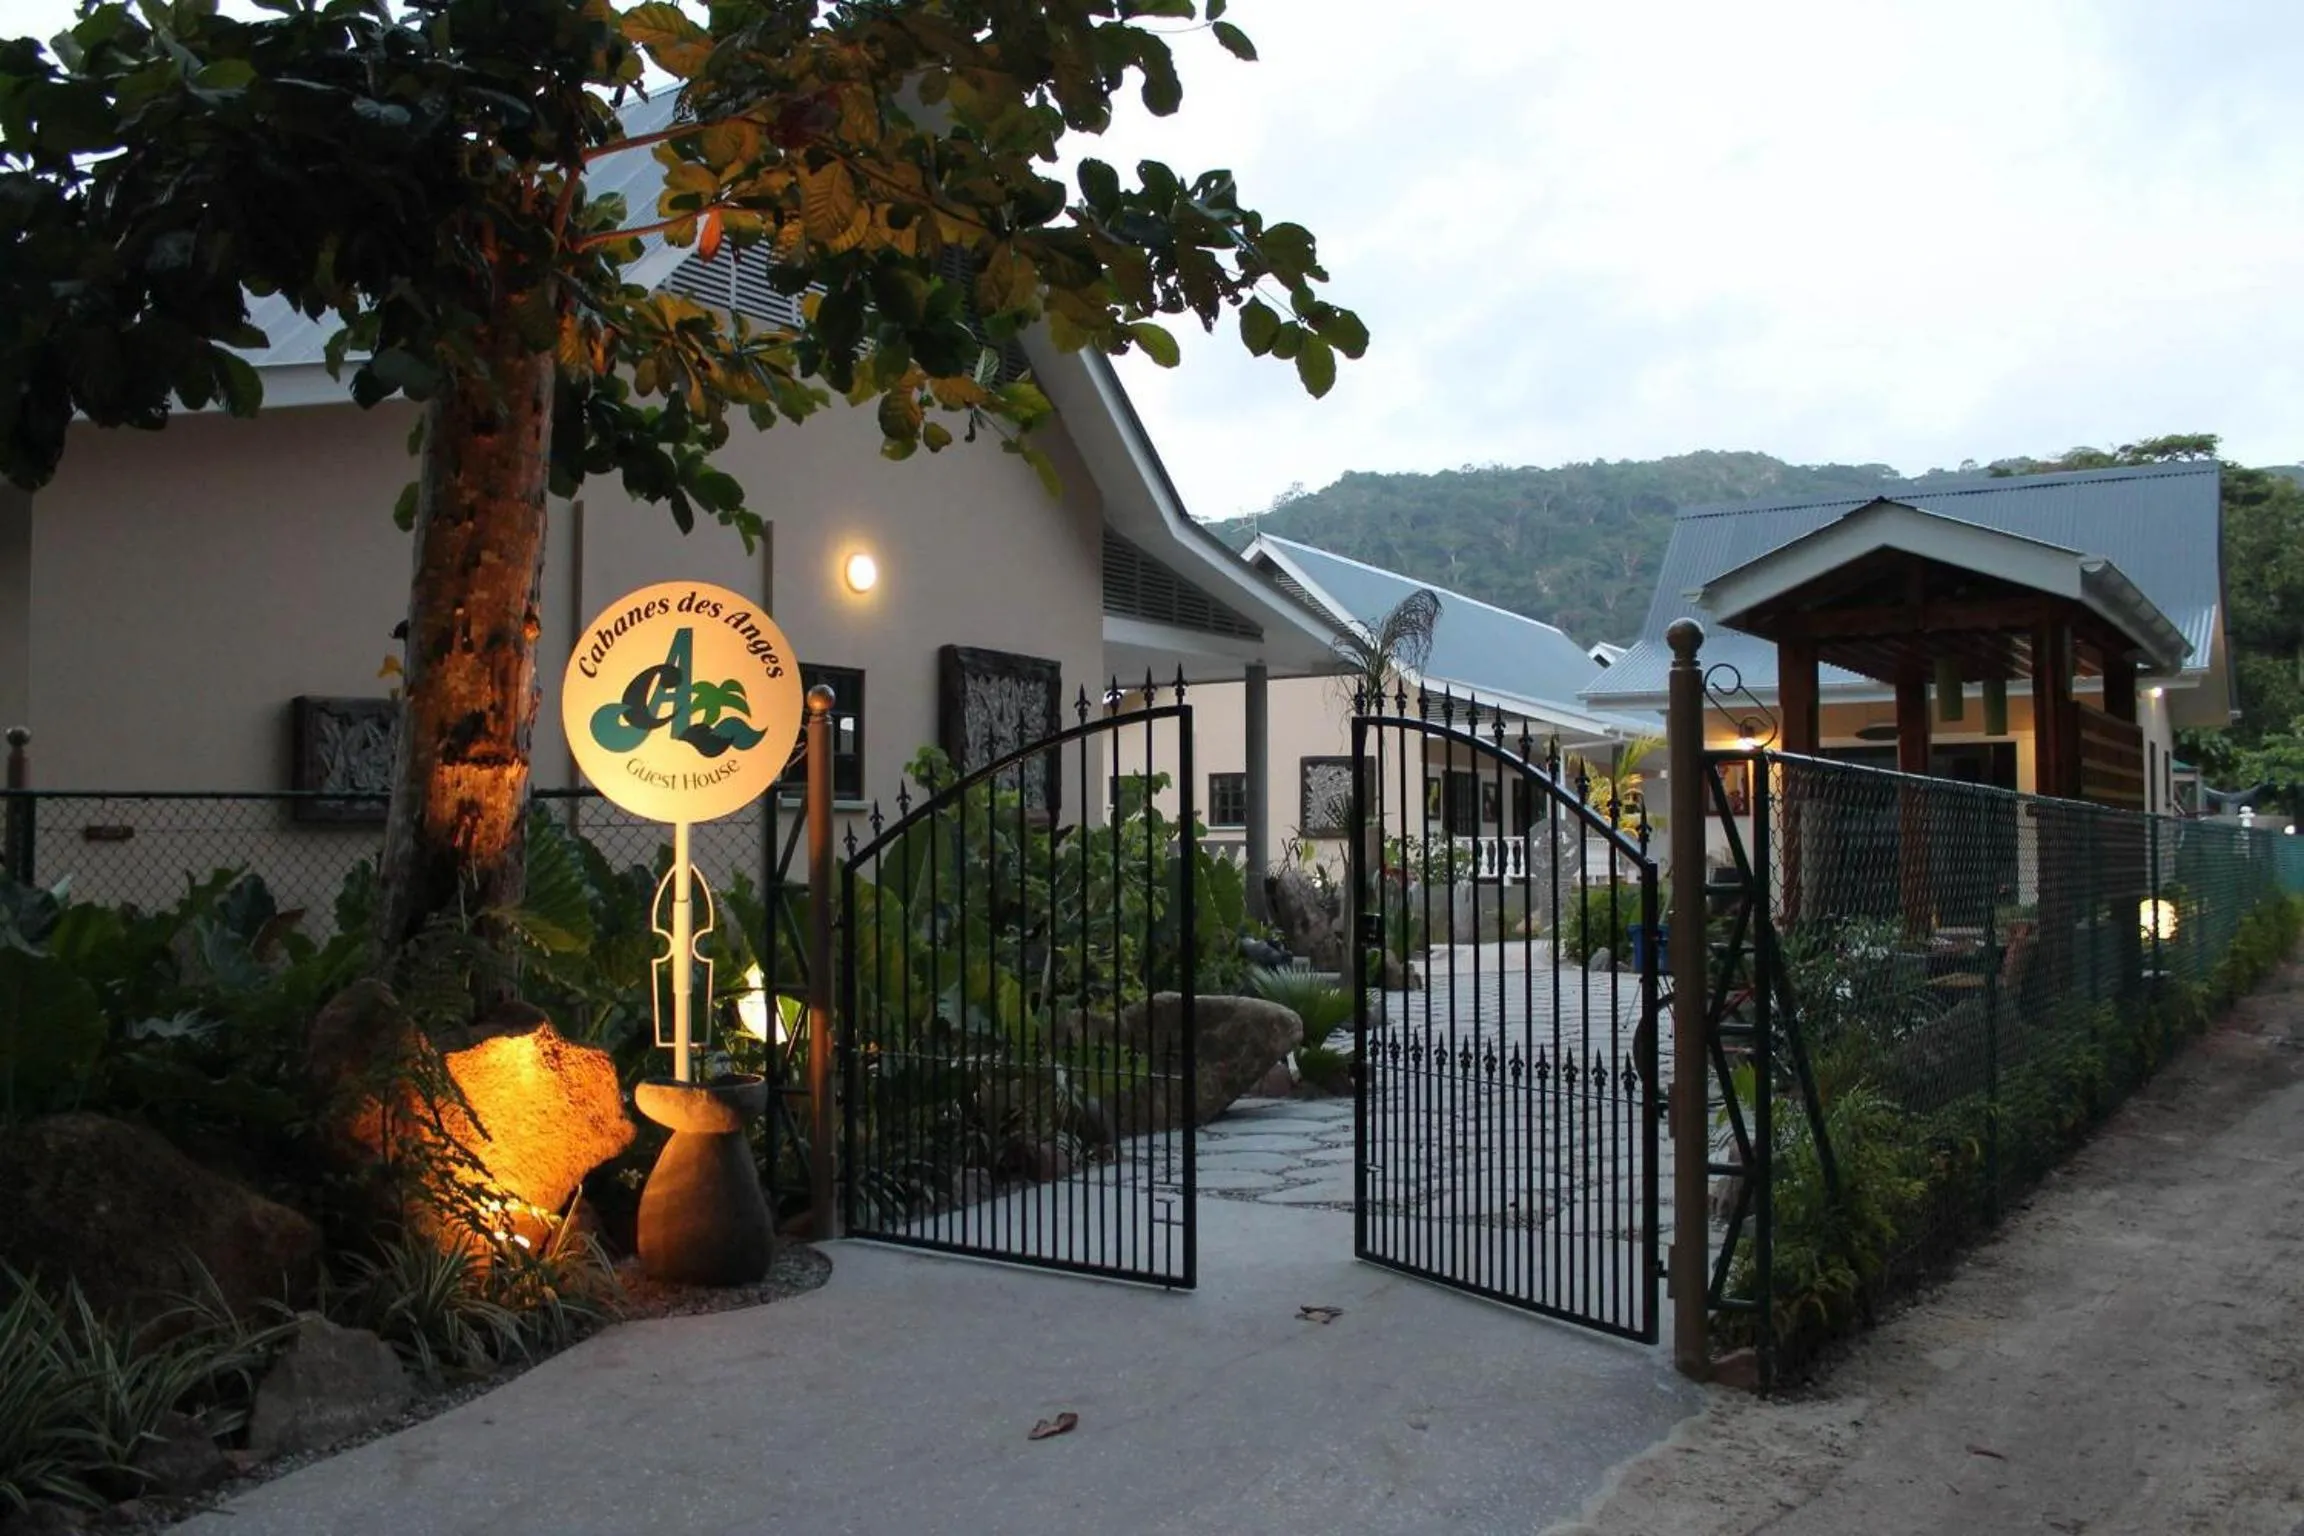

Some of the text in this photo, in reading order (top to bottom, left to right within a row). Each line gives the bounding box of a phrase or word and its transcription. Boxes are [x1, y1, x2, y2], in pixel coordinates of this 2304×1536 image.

[578, 592, 784, 679] Cabanes des Anges
[626, 758, 740, 791] Guest House
